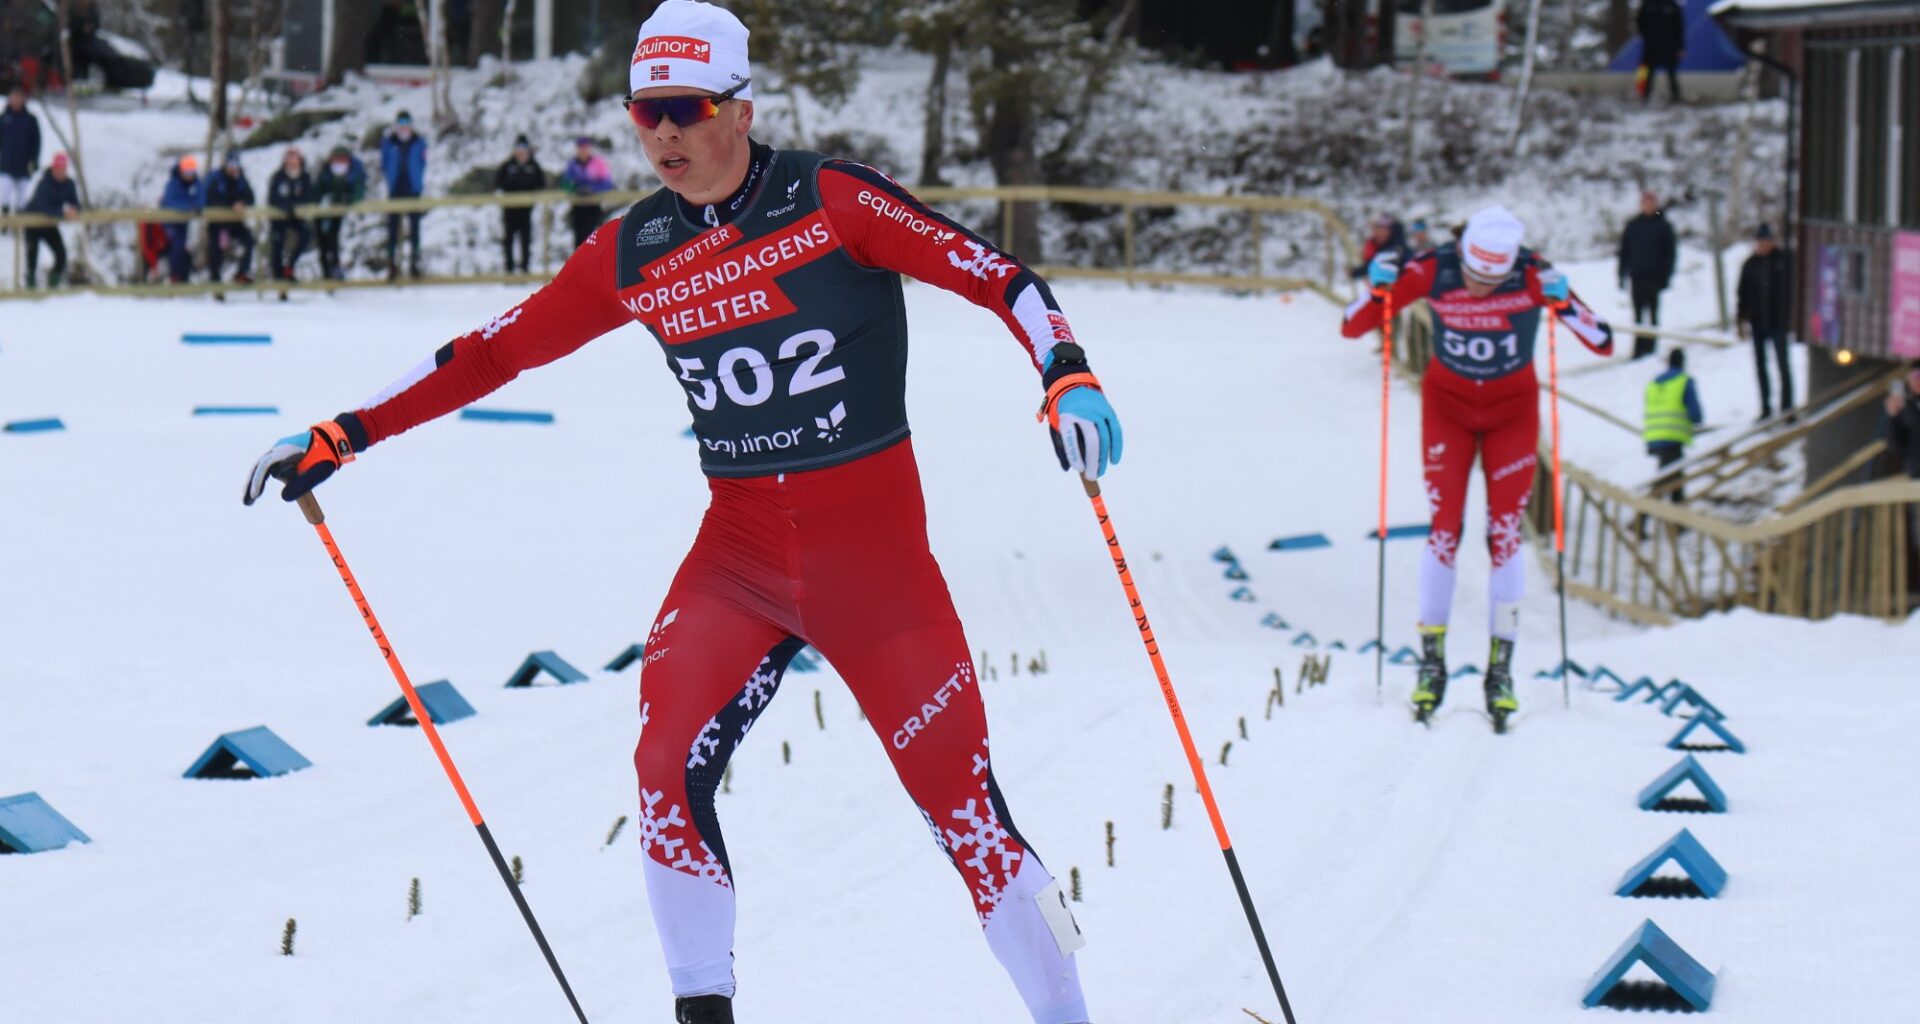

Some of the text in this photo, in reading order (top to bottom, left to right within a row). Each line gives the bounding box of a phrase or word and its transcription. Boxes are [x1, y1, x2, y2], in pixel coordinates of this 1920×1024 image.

[766, 203, 796, 218] equinor
[858, 190, 937, 236] equinor
[622, 223, 830, 316] MORGENDAGENS
[650, 229, 731, 280] VI STØTTER
[661, 290, 770, 337] HELTER
[675, 328, 846, 411] 502
[1443, 330, 1518, 362] 501
[893, 673, 963, 750] CRAFT
